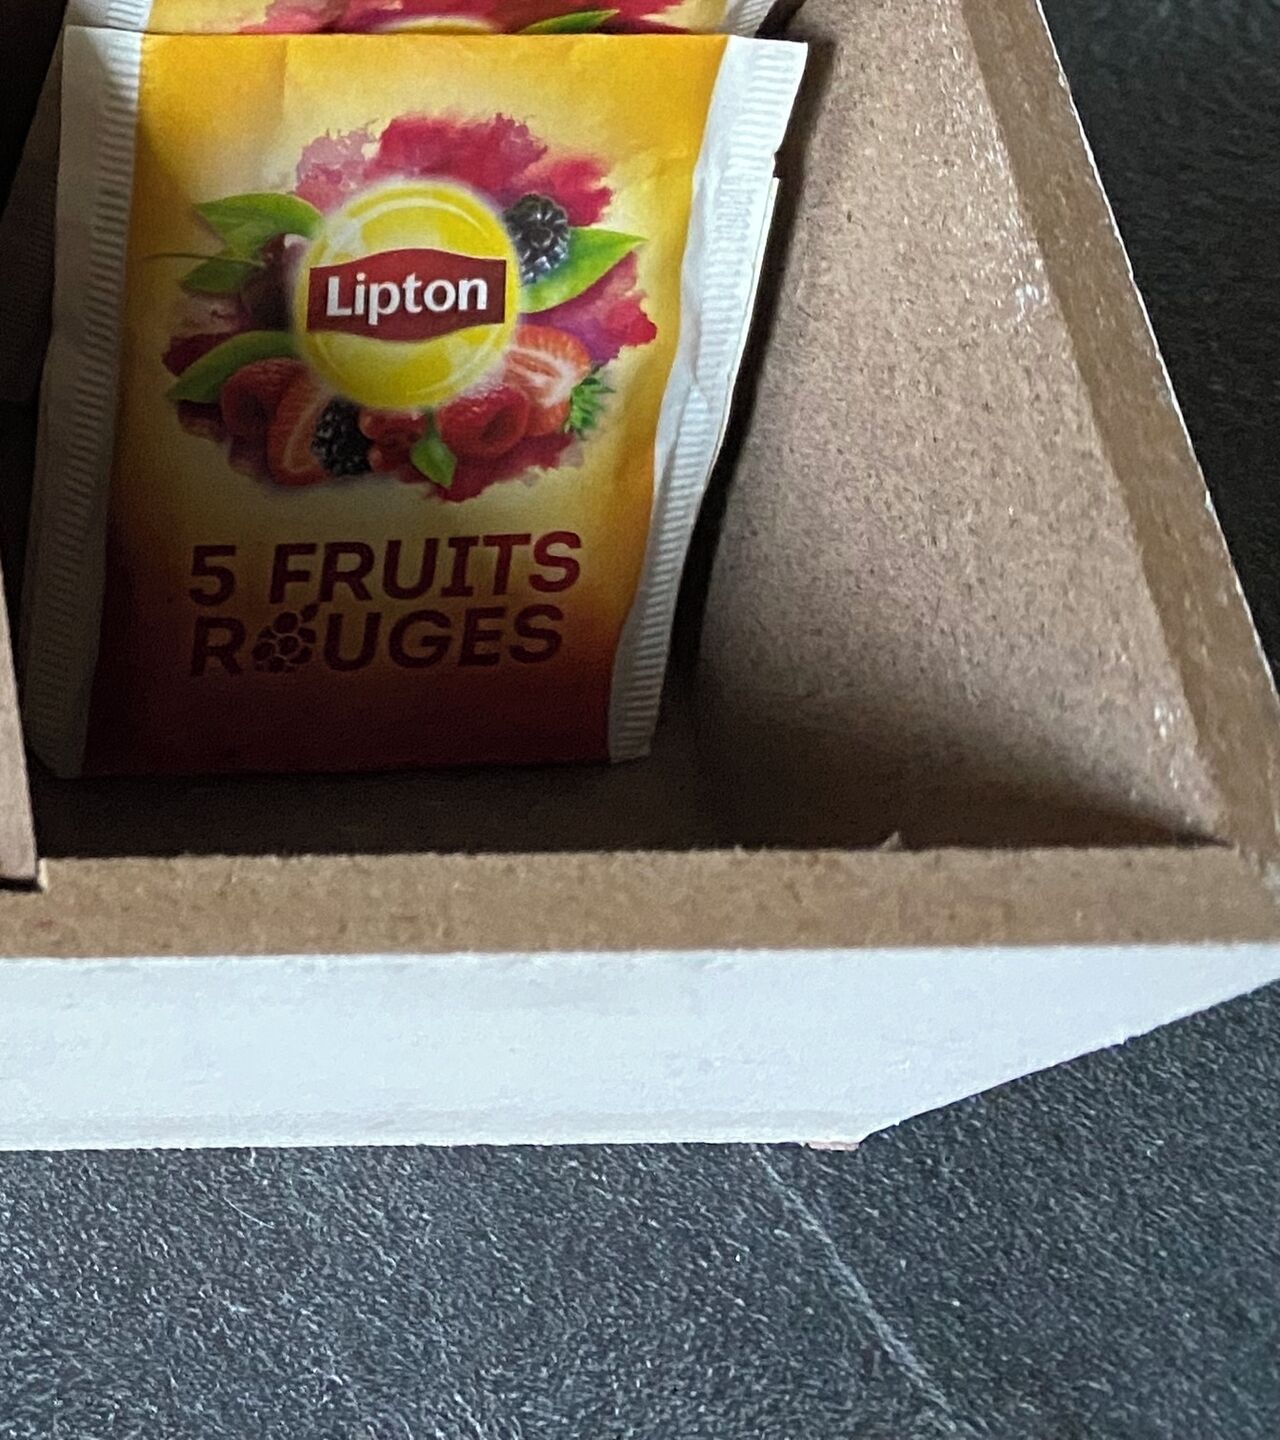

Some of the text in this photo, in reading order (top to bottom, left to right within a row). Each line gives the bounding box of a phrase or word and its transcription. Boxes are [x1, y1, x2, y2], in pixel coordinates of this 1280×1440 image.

[326, 271, 489, 327] Lipton
[188, 530, 582, 607] 5 FRUITS
[190, 603, 564, 678] ROUGES
